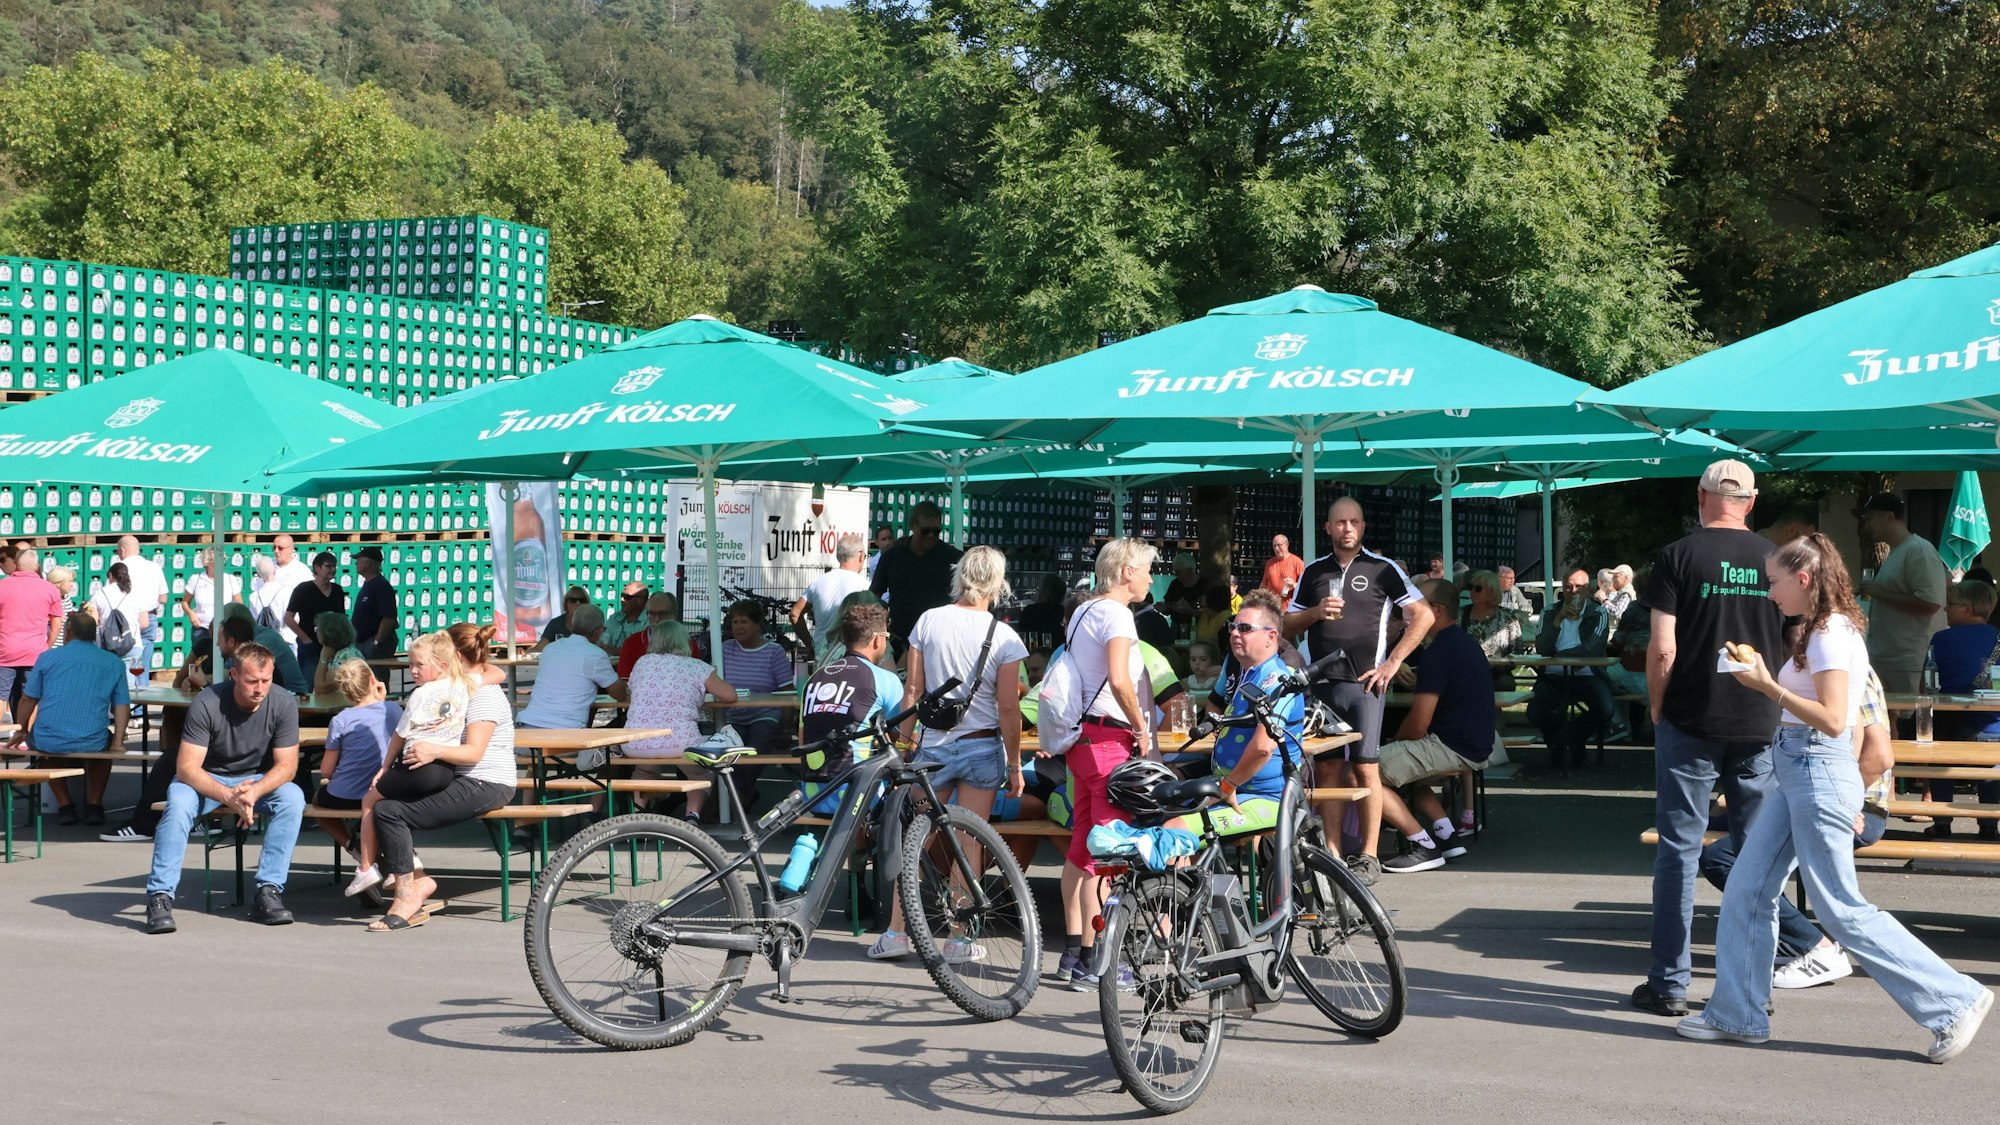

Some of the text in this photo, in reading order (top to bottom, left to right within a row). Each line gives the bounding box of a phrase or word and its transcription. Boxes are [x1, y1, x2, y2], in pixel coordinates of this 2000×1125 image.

[1117, 365, 1415, 398] Zunft KÖLSCH
[478, 400, 737, 441] Zunft KÖLSCH
[83, 435, 212, 464] KÖLSCH
[718, 500, 751, 515] KÖLSCH
[680, 527, 724, 538] Wamos
[694, 538, 744, 551] Geänke
[766, 515, 816, 561] Zunft
[716, 551, 747, 561] ervice
[1721, 561, 1758, 585] Team
